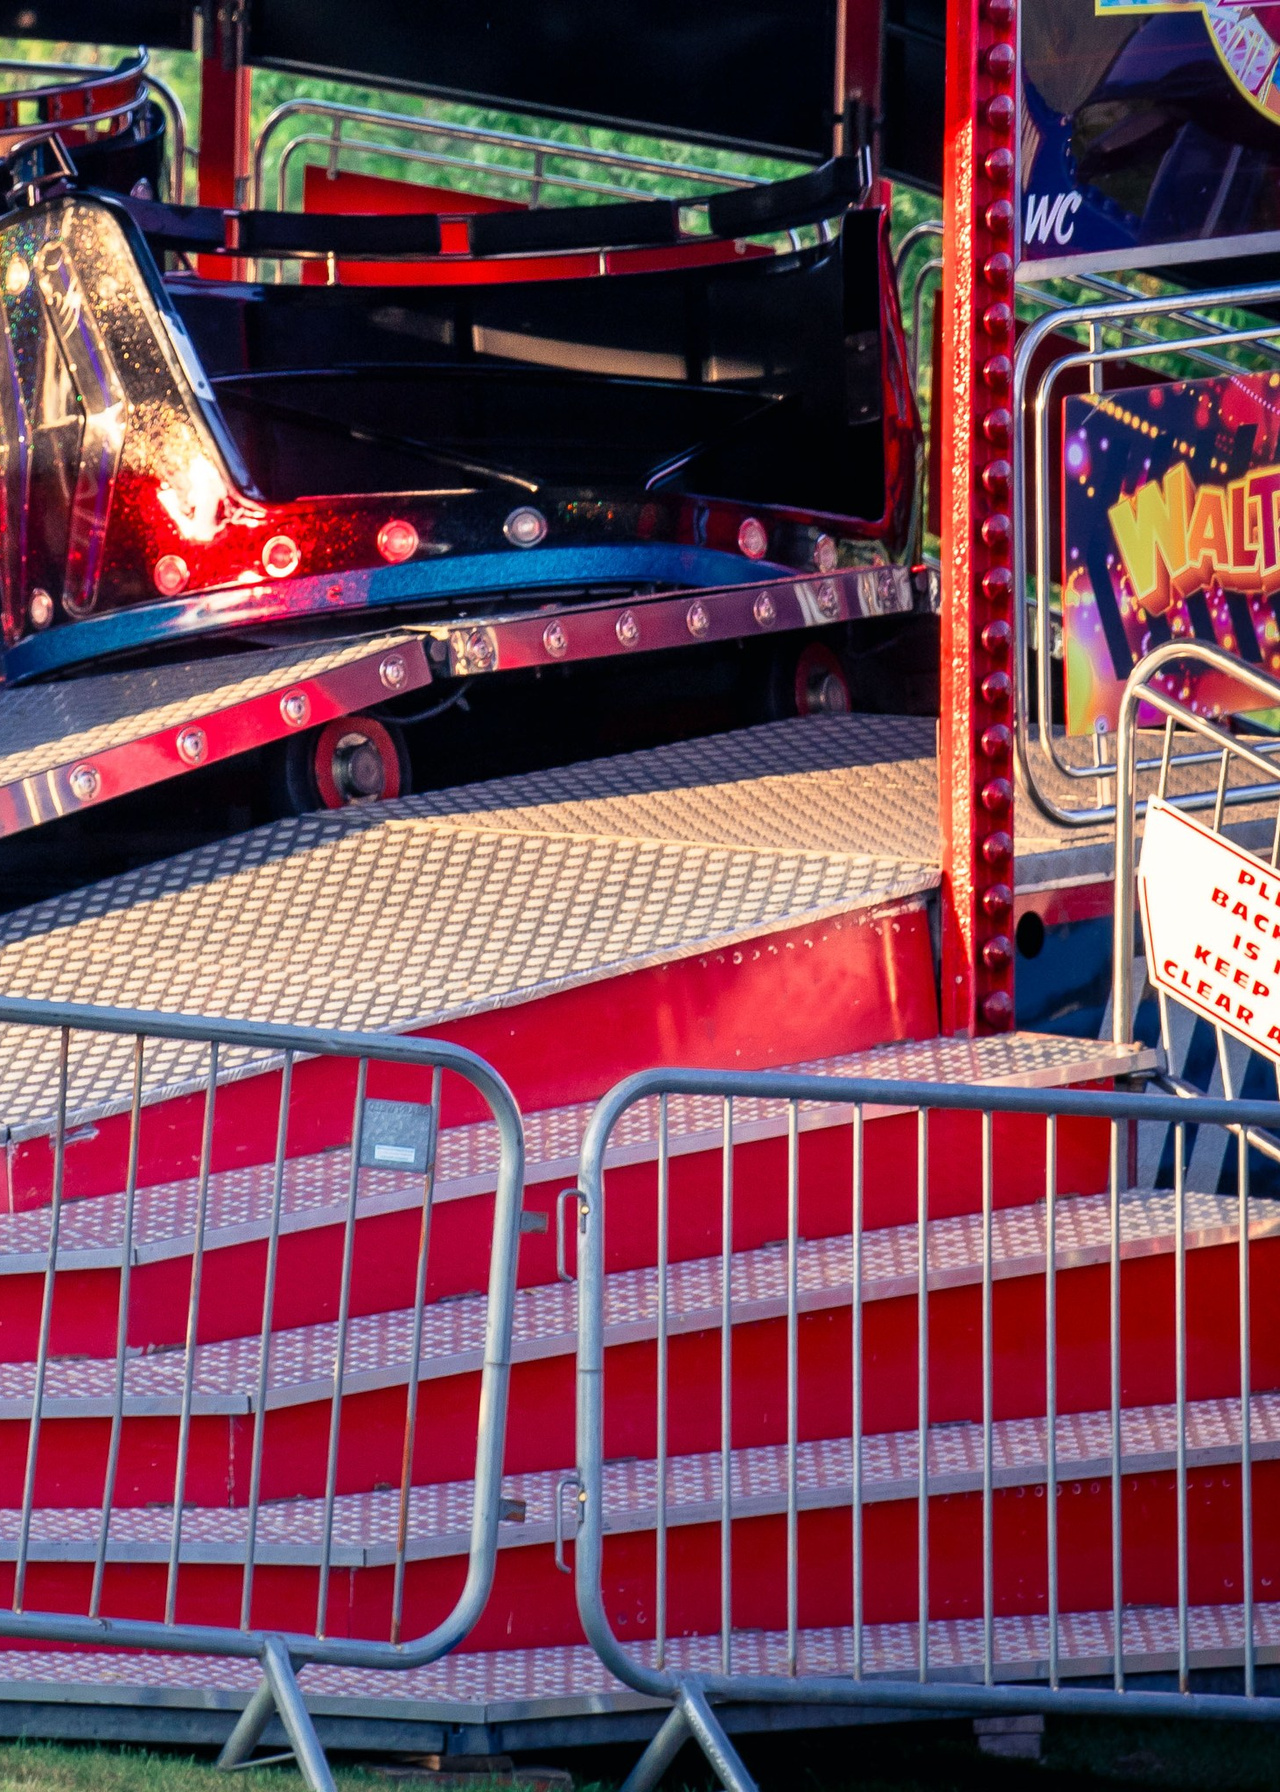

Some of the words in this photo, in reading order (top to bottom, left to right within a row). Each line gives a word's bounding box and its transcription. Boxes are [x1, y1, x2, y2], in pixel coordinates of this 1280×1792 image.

[1024, 191, 1083, 245] WC
[1194, 945, 1270, 997] KEEP
[1232, 934, 1260, 961] IS
[1163, 959, 1254, 1026] CLEAR
